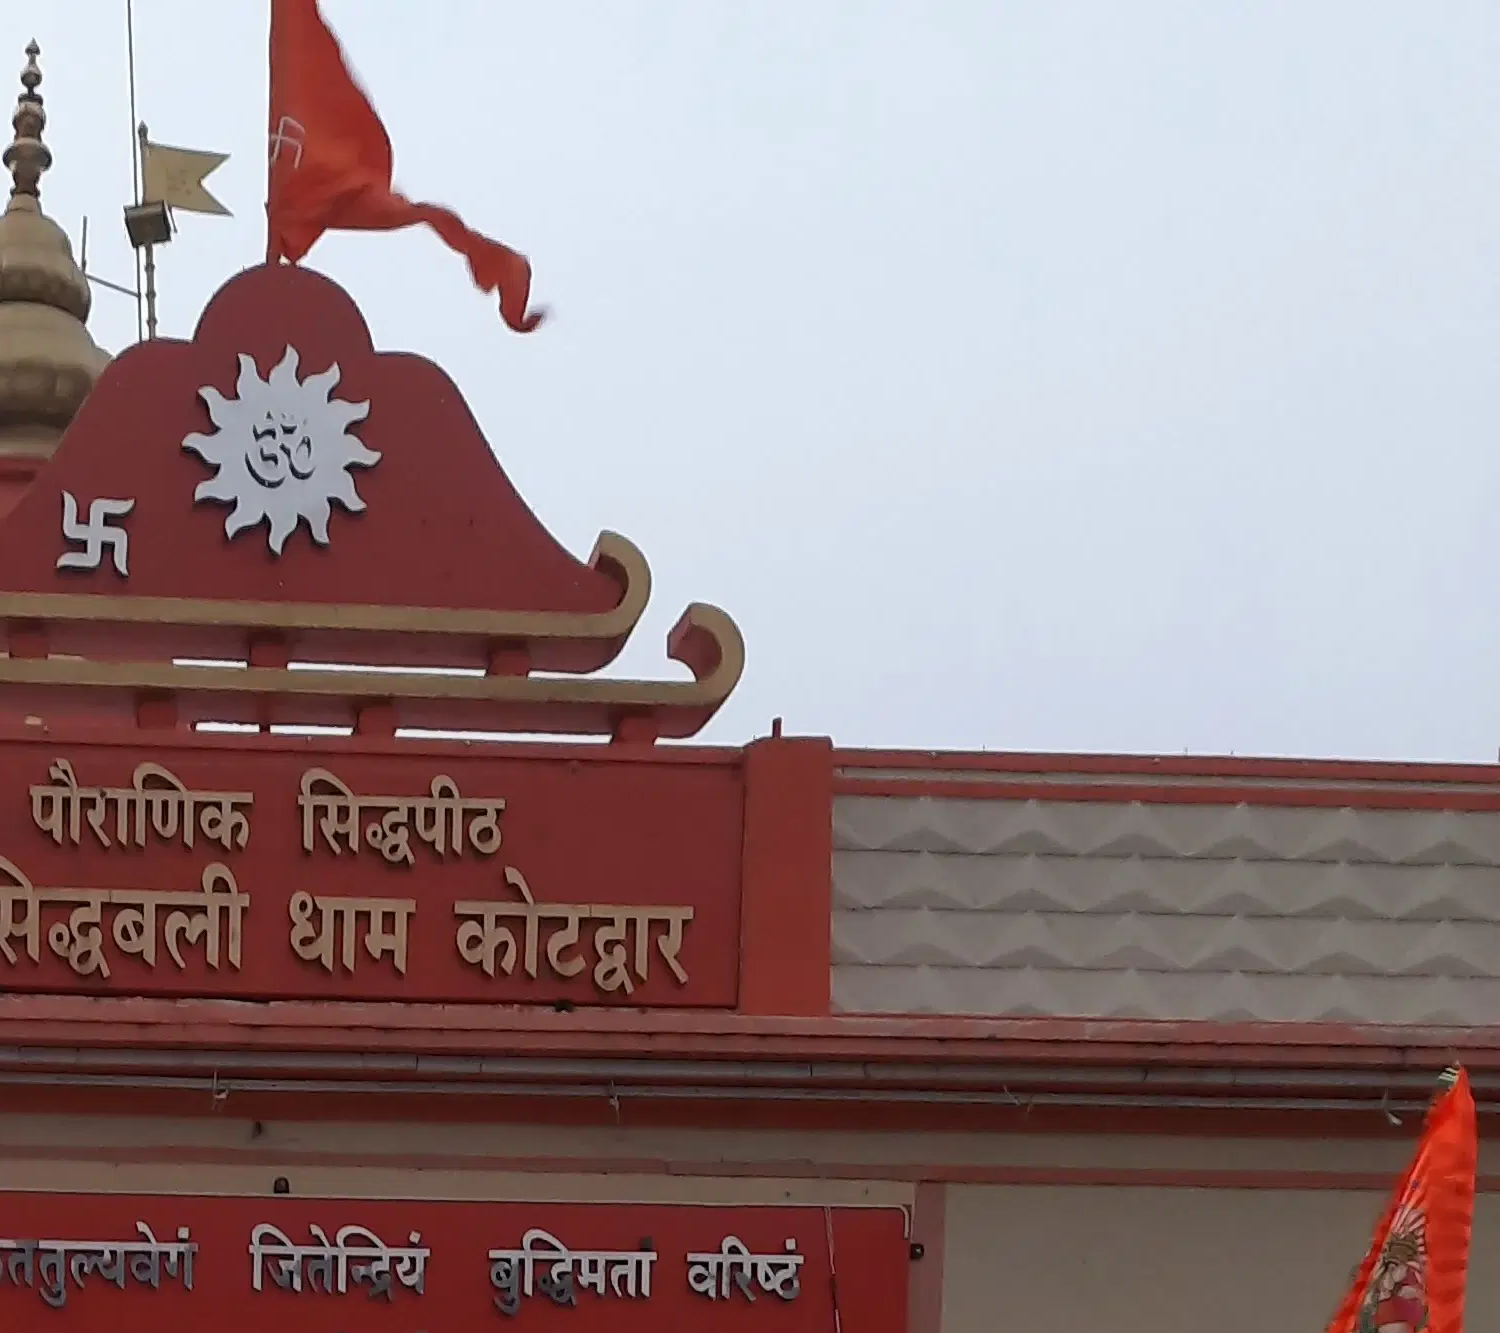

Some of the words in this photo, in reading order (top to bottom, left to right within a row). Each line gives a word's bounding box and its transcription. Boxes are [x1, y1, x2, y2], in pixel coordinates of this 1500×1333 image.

[29, 757, 254, 851] पौराणिक
[297, 767, 506, 866] सिद्धपीठ
[289, 890, 416, 976] धाम
[454, 865, 694, 995] कोटद्वार
